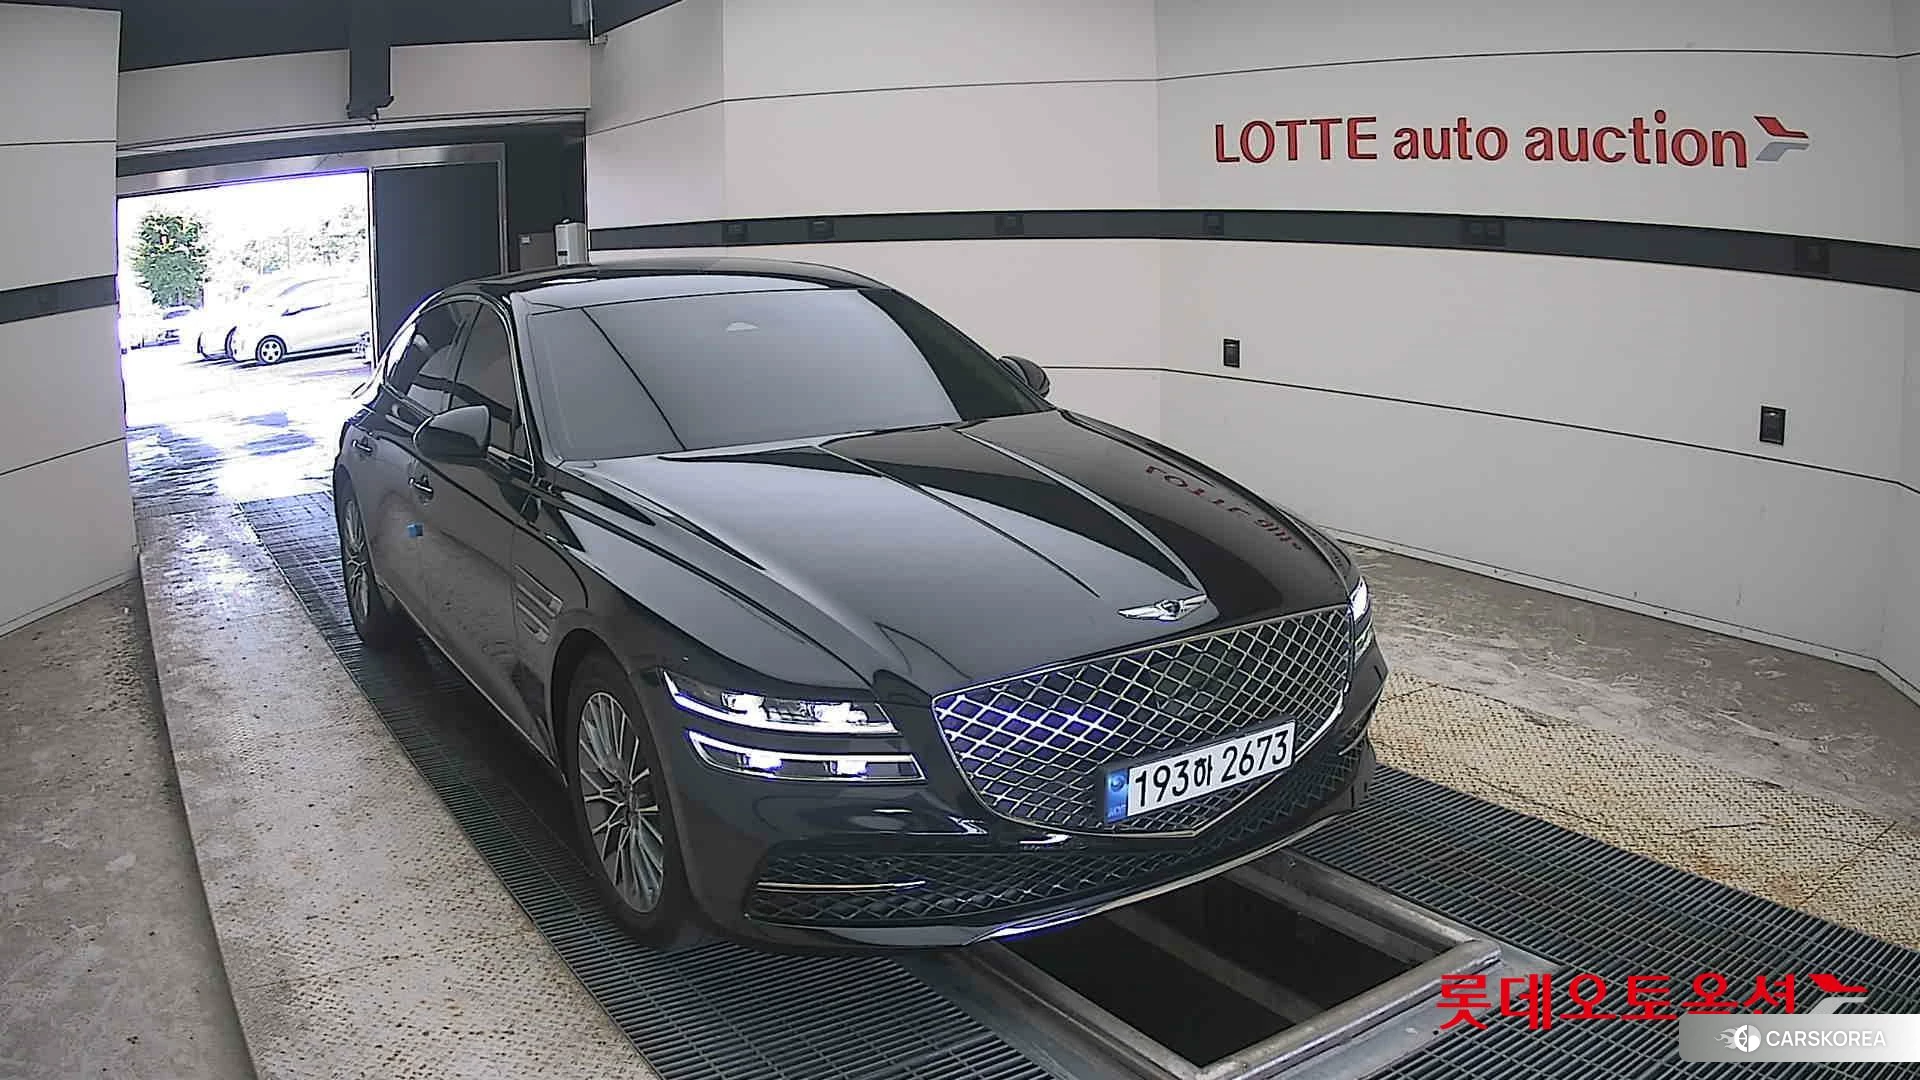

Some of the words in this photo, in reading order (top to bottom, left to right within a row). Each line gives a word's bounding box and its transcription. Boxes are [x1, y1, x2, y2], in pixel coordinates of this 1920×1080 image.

[1214, 116, 1378, 164] LOTTE
[1392, 117, 1510, 162] auto
[1524, 109, 1750, 169] auction
[1134, 757, 1213, 808] 193하
[1220, 729, 1290, 784] 2673
